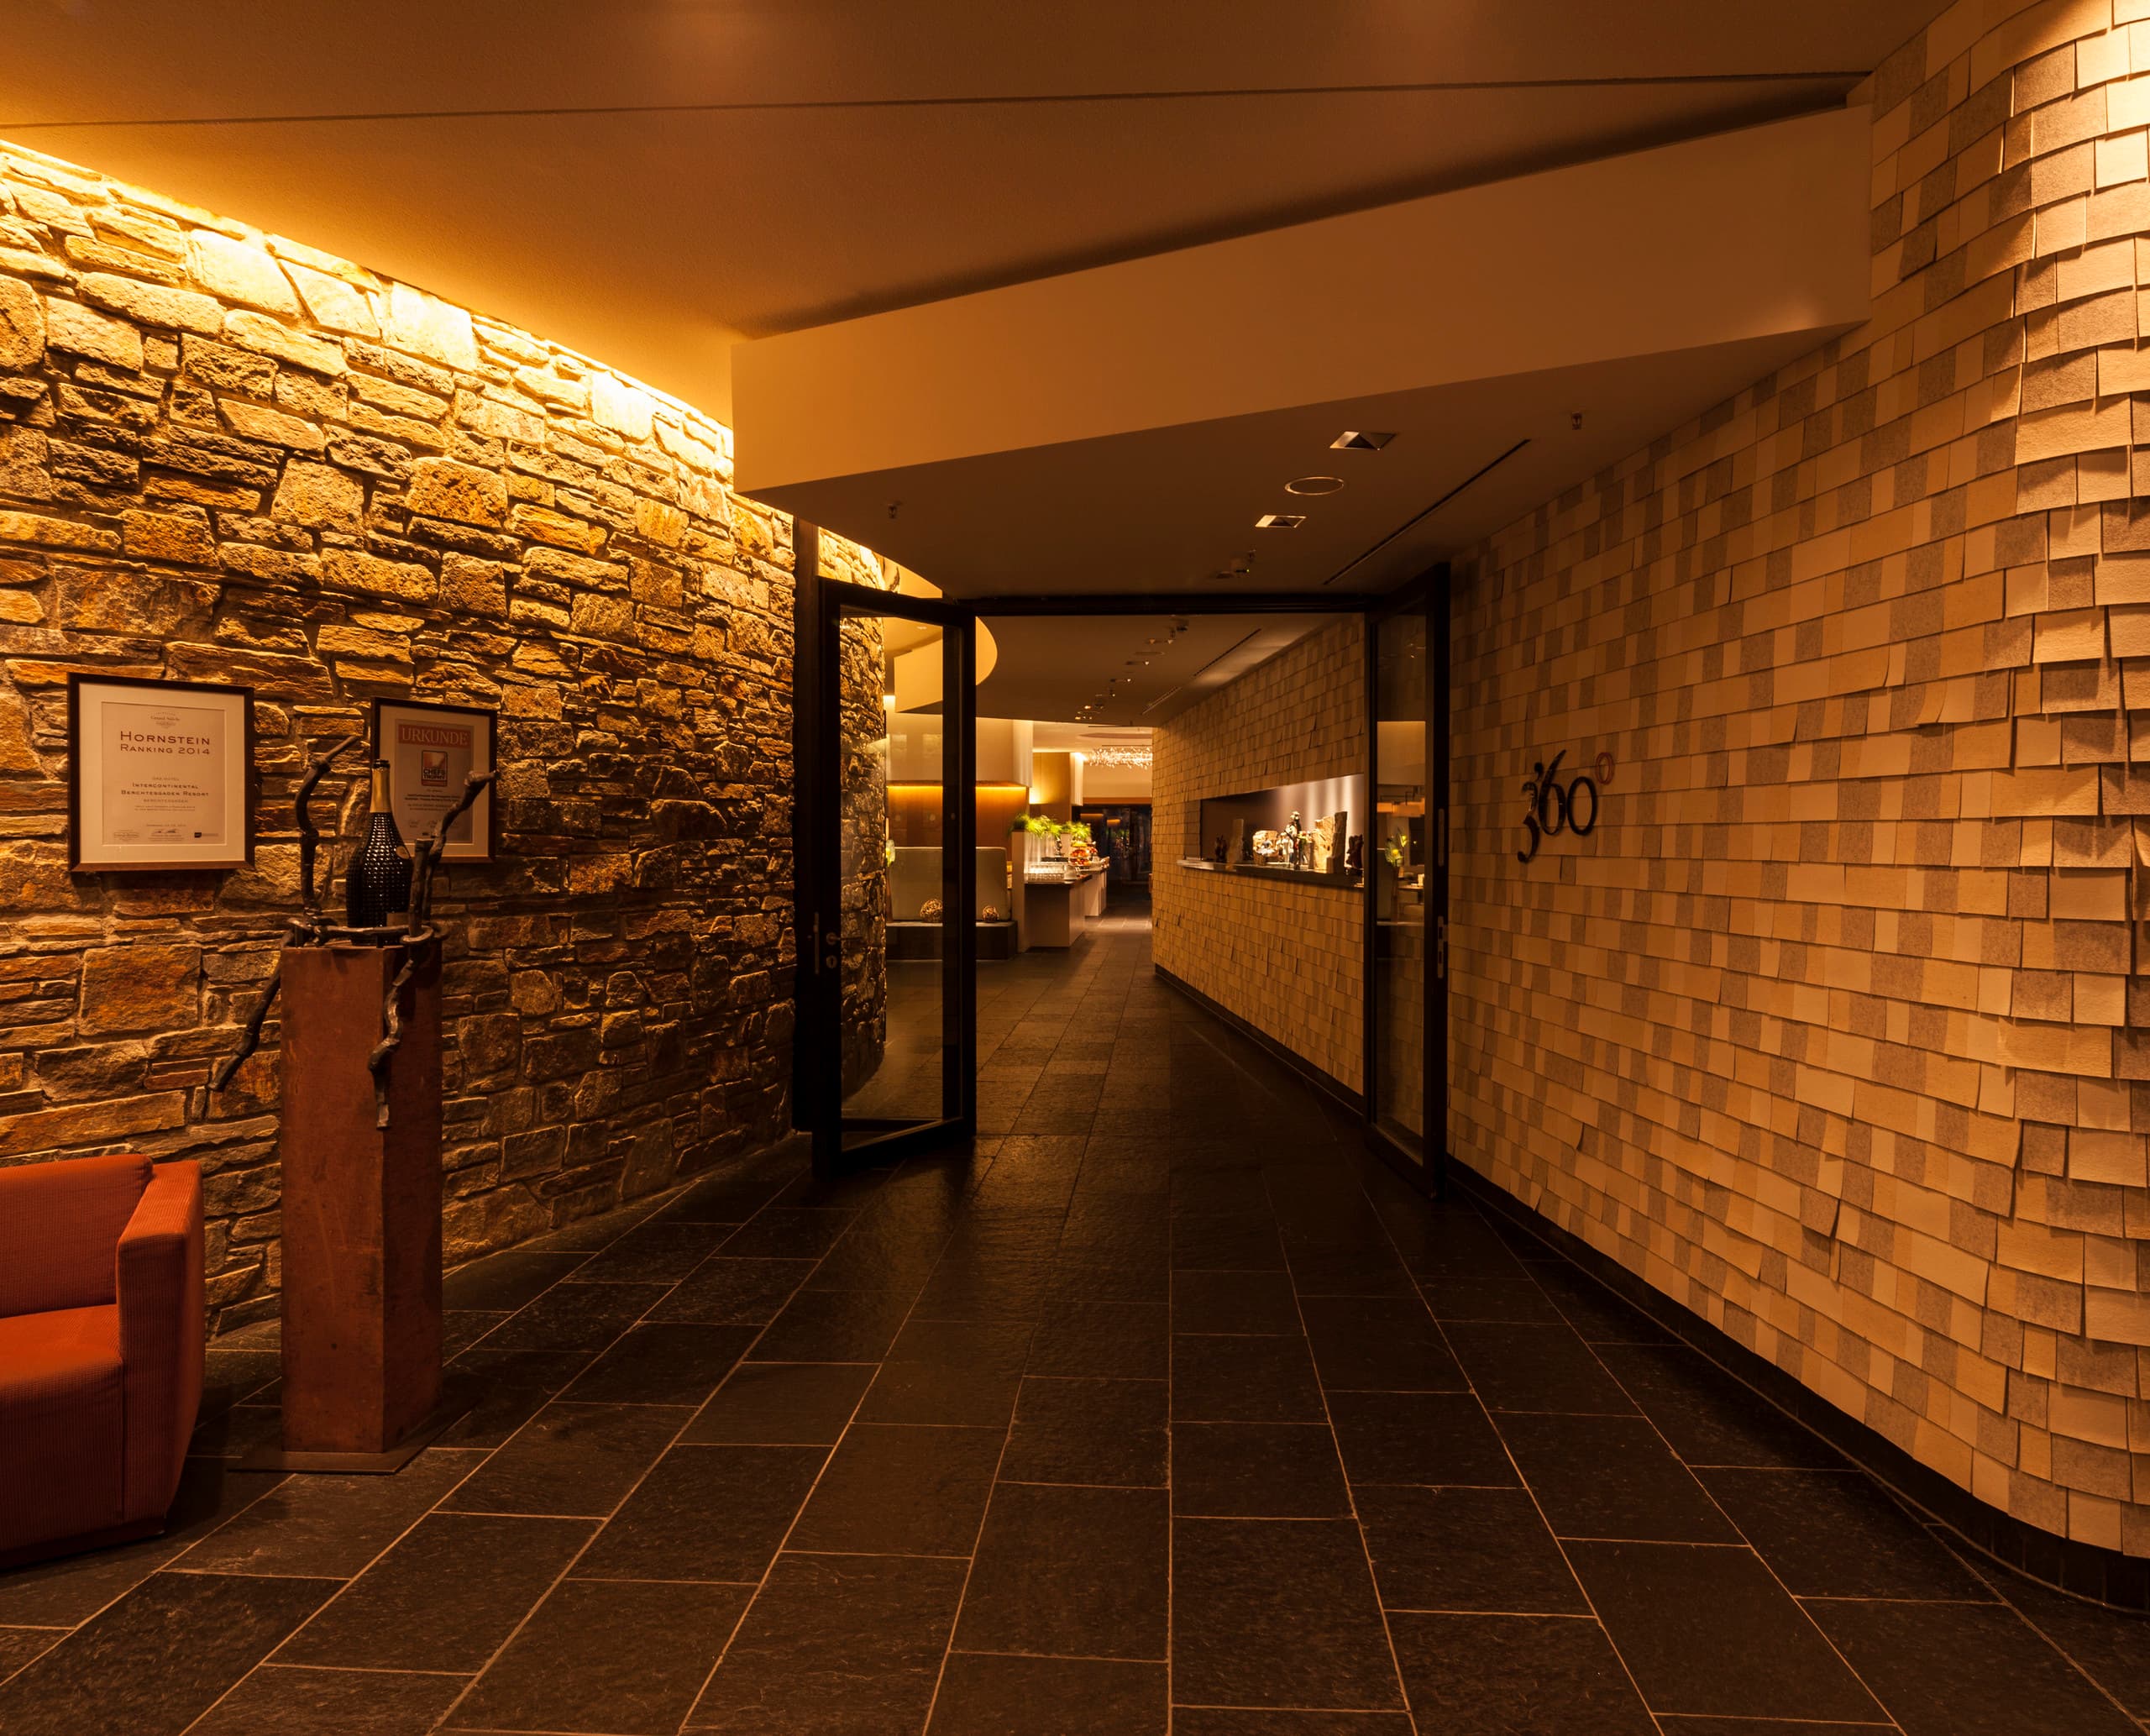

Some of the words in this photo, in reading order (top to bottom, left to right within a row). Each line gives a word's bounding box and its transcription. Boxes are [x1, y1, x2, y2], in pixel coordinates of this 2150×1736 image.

[120, 731, 210, 745] HORNSTEIN
[402, 727, 467, 745] URKUNDE
[120, 744, 173, 753] RANKING
[178, 747, 210, 755] 2014
